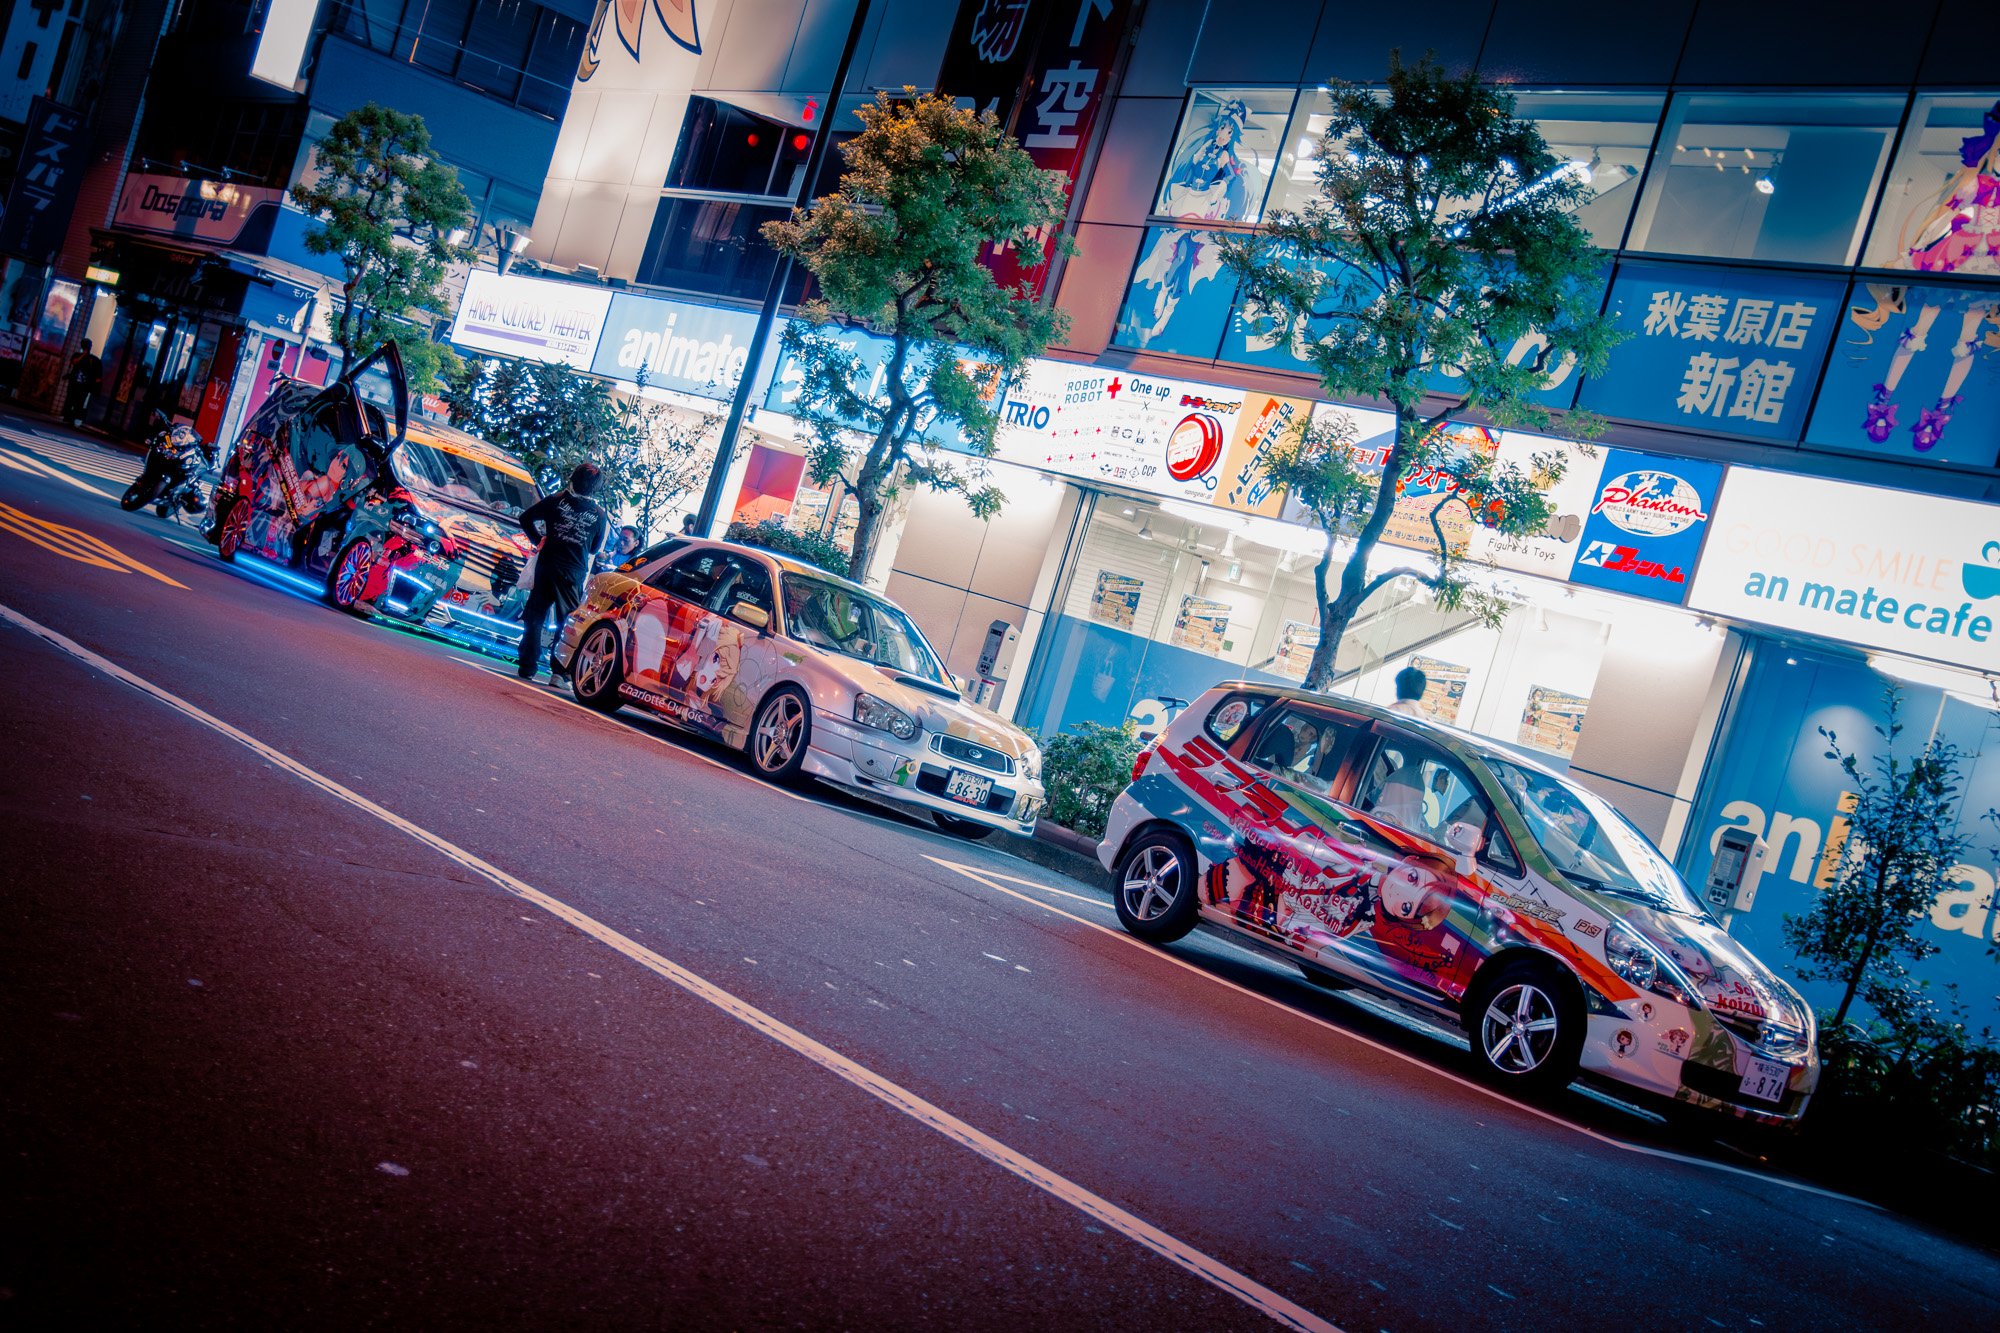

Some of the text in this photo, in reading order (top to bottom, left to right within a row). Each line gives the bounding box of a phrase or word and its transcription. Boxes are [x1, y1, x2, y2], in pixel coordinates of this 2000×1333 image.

[140, 185, 228, 221] Dospara
[549, 300, 597, 341] THEATER
[1643, 290, 1818, 351] 秋葉原店
[617, 313, 748, 389] animate
[1067, 378, 1105, 392] ROBOT
[1130, 378, 1152, 395] One
[1677, 352, 1796, 423] 新館
[422, 395, 441, 408] au
[1064, 391, 1102, 404] ROBOT
[1179, 394, 1242, 415] ヨーヨーショップ
[1142, 465, 1157, 477] CCP
[1592, 487, 1707, 520] Phantom
[1625, 507, 1639, 516] ARMY
[1652, 512, 1674, 522] SURPLUS
[1674, 516, 1690, 524] STORE
[1521, 546, 1529, 554] &
[1534, 547, 1556, 561] Toys
[1603, 545, 1685, 583] ファントム
[1725, 522, 1953, 593] GOOD SMILE
[618, 683, 667, 710] Charlotte
[954, 782, 988, 802] 86-30
